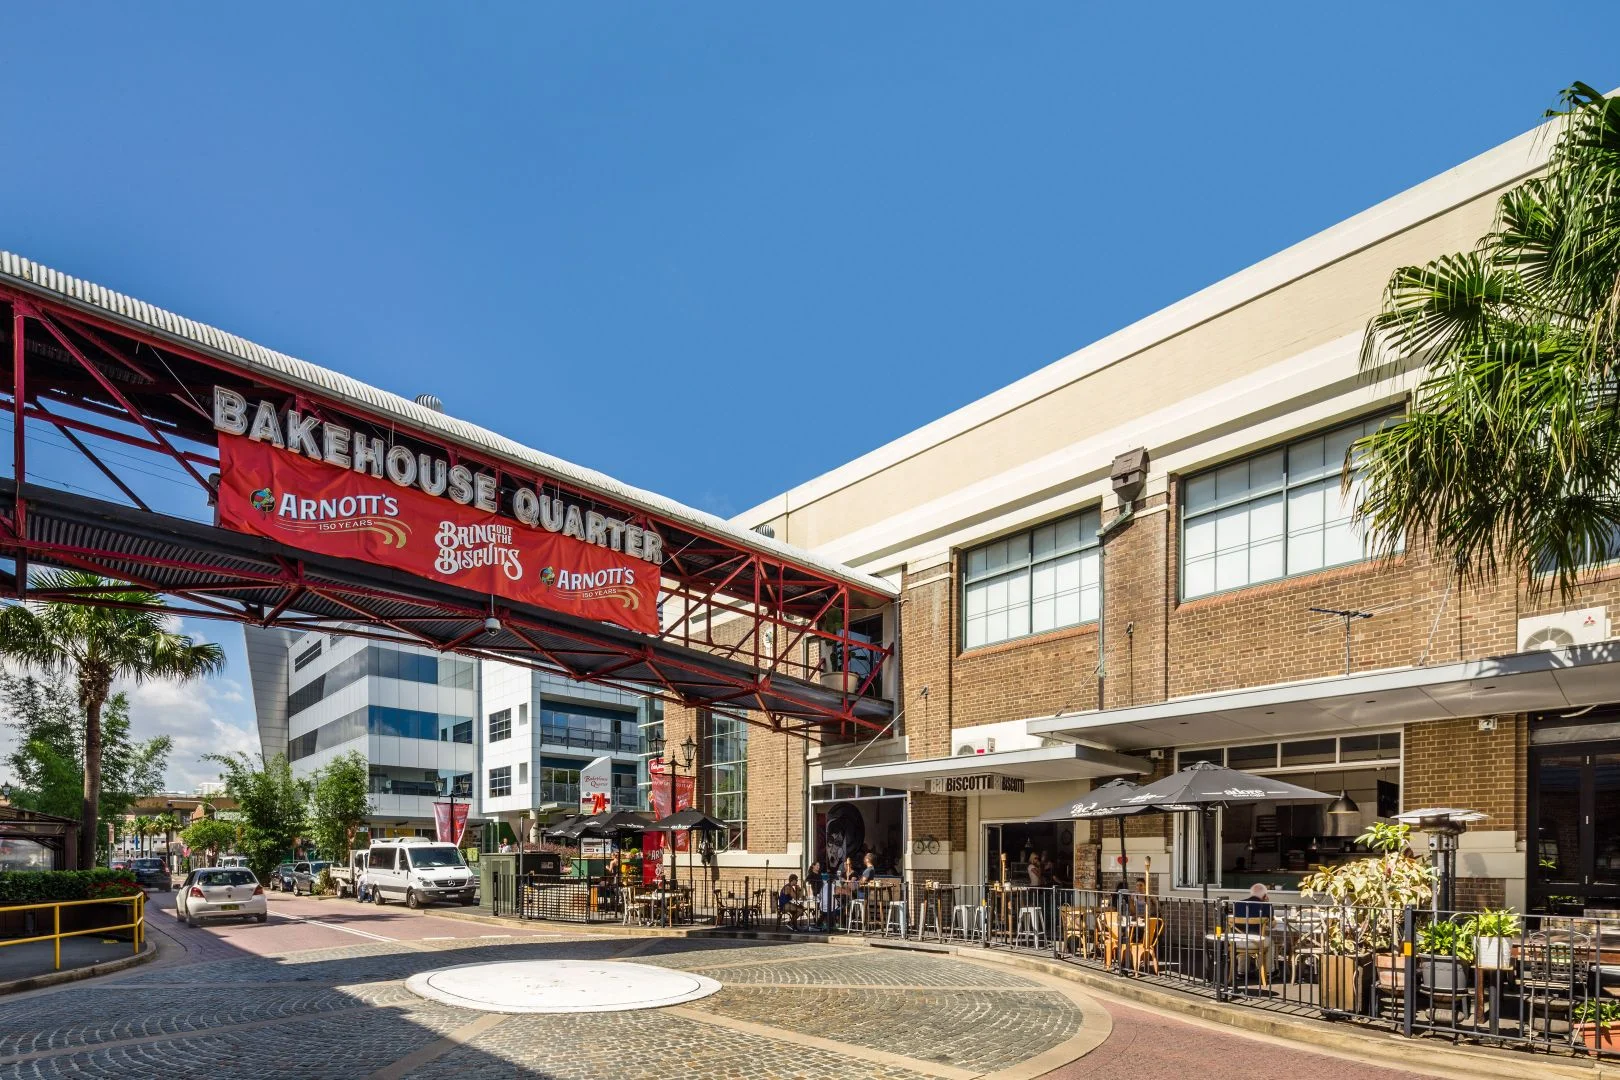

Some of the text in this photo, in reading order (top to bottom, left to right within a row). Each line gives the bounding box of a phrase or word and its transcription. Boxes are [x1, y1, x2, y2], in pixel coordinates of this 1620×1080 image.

[213, 384, 663, 565] BAKEHOUSE QUARTER
[277, 493, 399, 520] ARNOTT'S
[319, 519, 373, 531] 150 YEARS
[434, 520, 513, 550] BRING OUT
[496, 533, 513, 545] THE
[434, 543, 523, 580] BISCUITS
[556, 566, 635, 590] ARNOTT'S
[594, 588, 617, 597] YEARS
